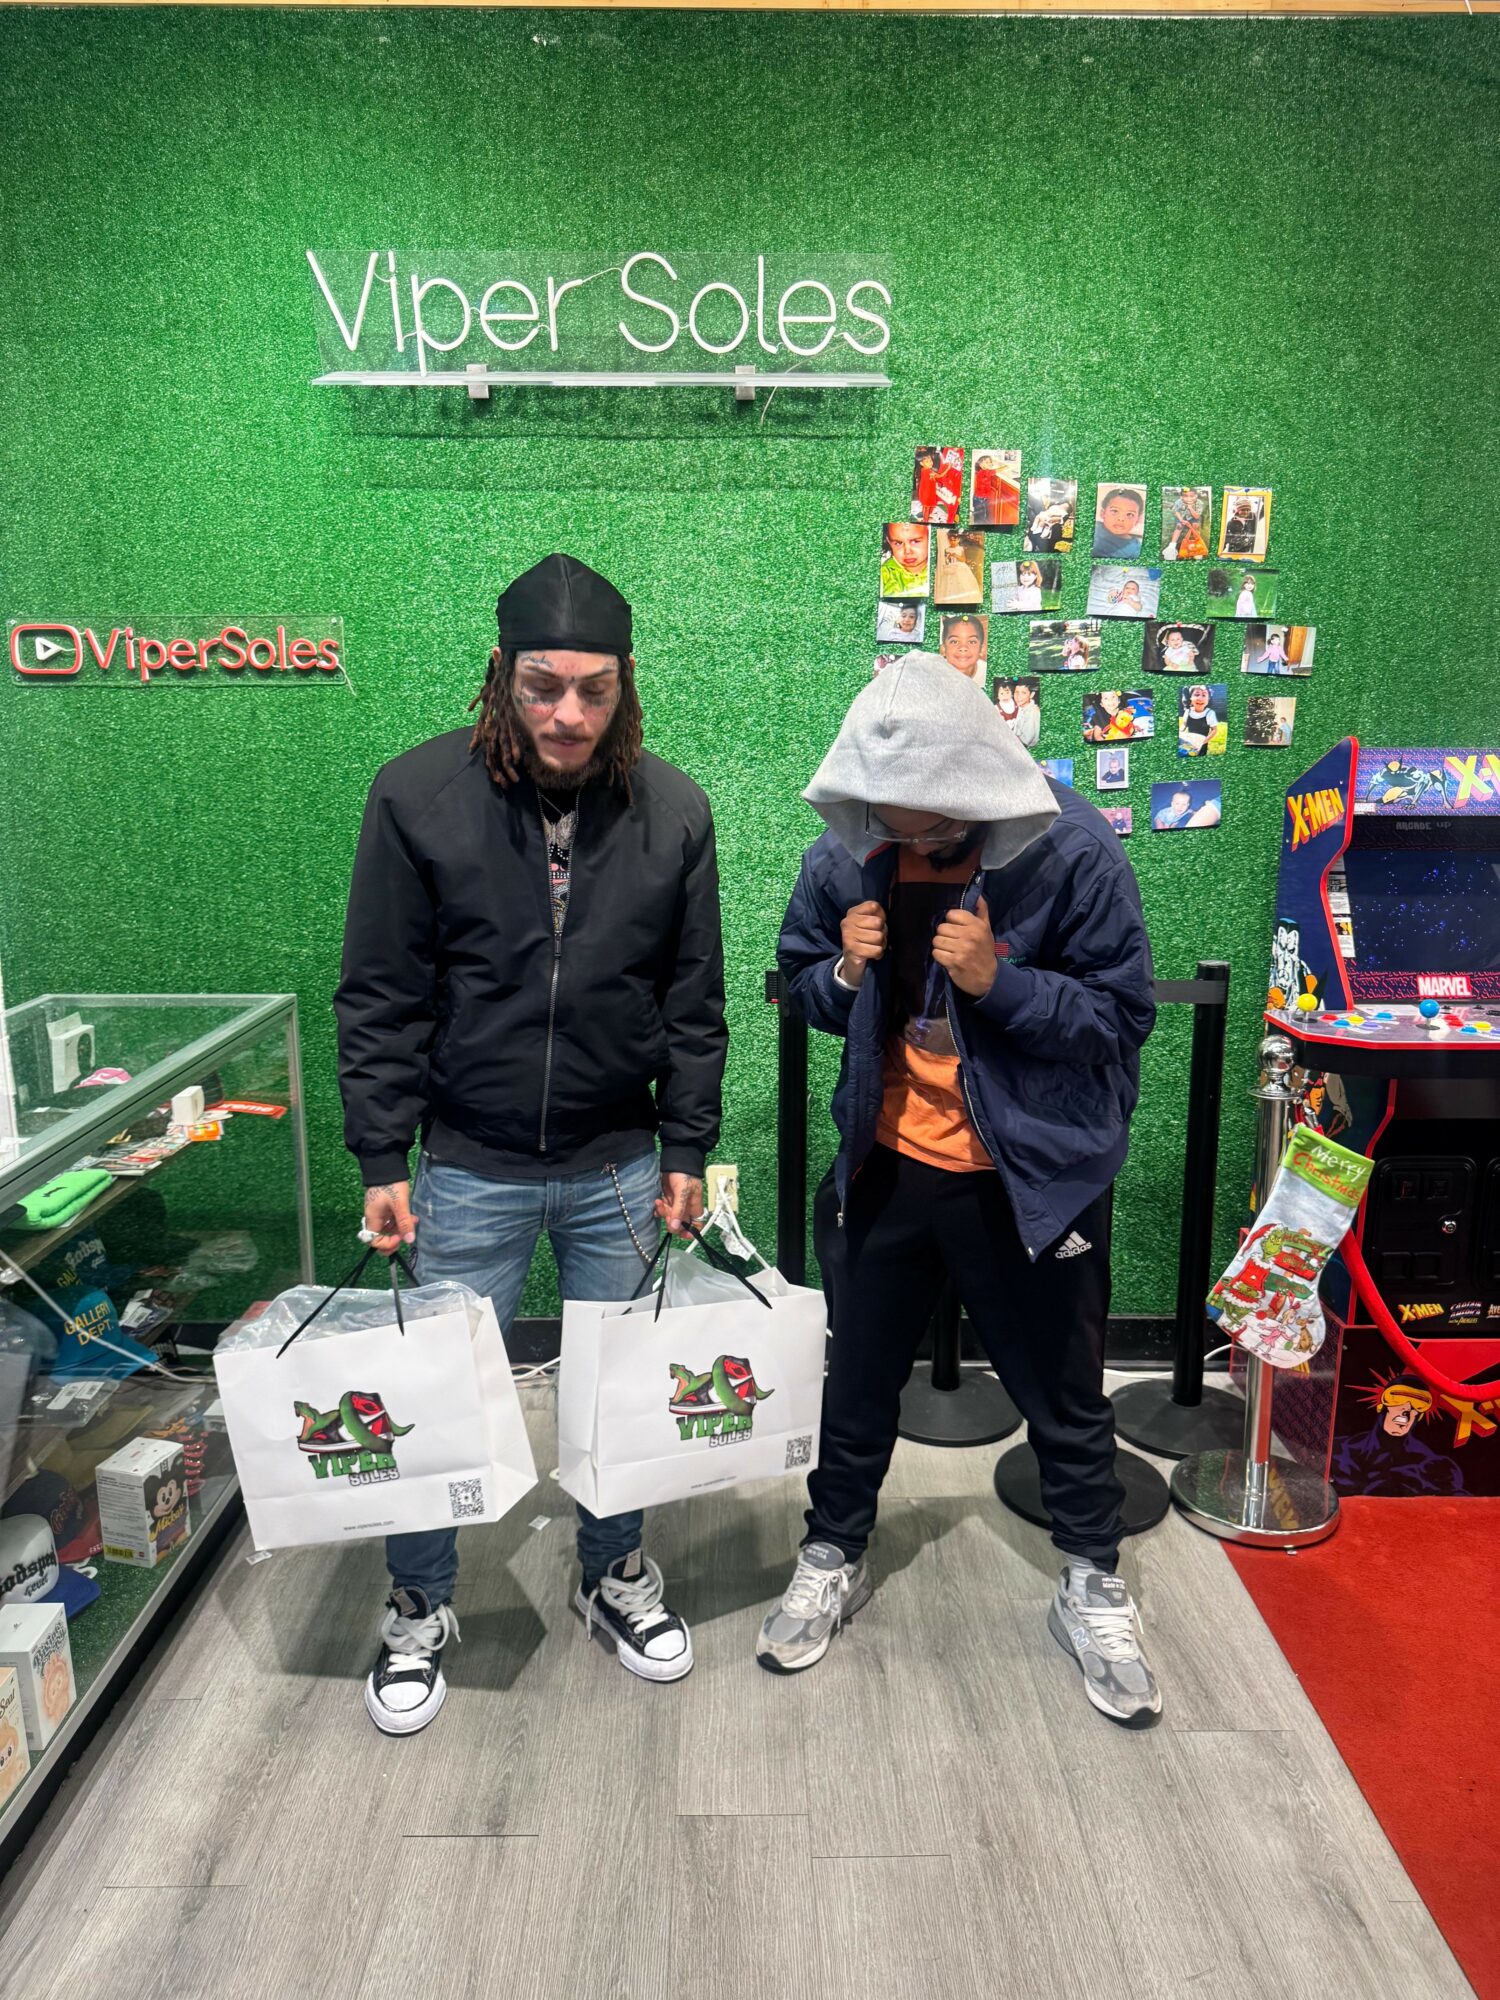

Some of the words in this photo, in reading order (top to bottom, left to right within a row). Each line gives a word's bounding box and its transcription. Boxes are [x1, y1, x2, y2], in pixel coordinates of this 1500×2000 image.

[305, 249, 585, 377] Viper
[618, 251, 892, 355] Soles
[84, 625, 339, 682] ViperSoles
[1287, 787, 1345, 852] X-MEN
[1417, 976, 1472, 997] MARVEL
[1293, 1151, 1361, 1201] Christmas
[1311, 1145, 1367, 1183] Merry
[1055, 1241, 1092, 1259] adidas
[1398, 1303, 1445, 1324] X-MEN
[675, 1411, 754, 1441] VIPER
[709, 1429, 754, 1448] SOLES
[307, 1449, 397, 1479] VIPER
[349, 1468, 400, 1486] SOLES
